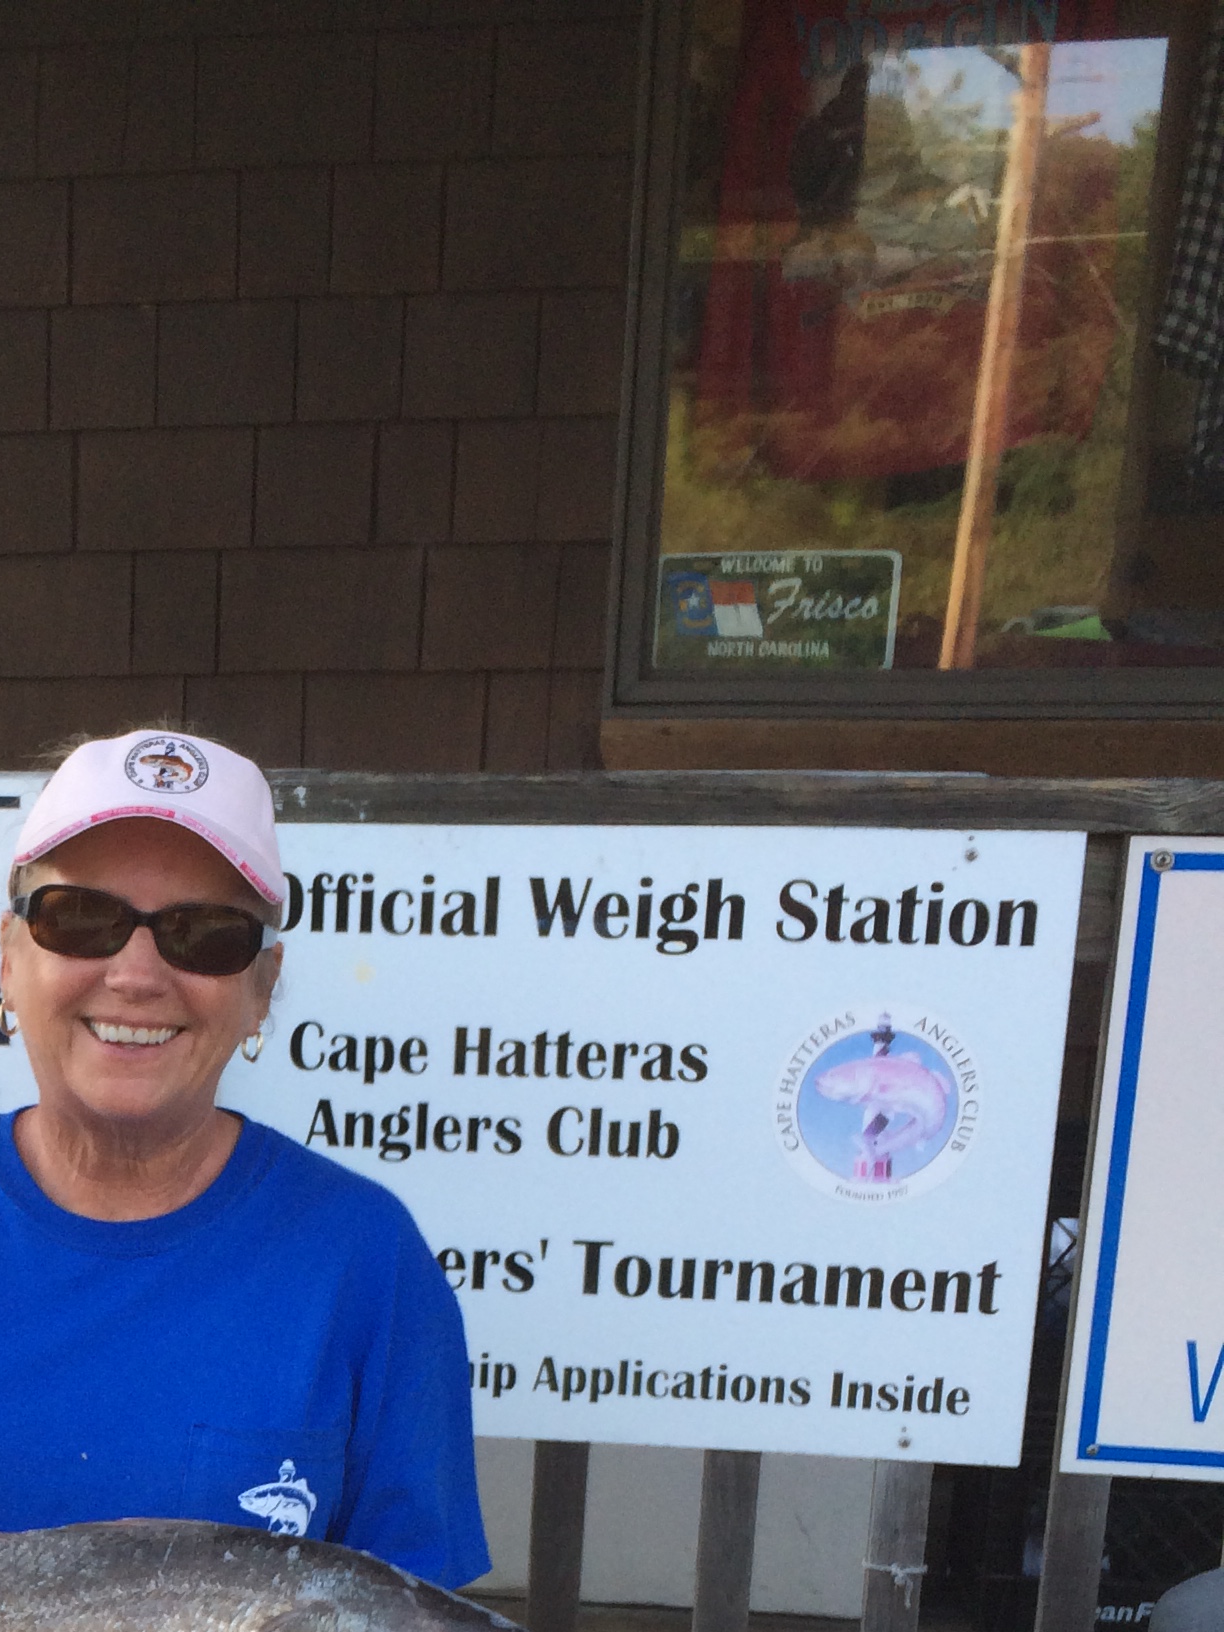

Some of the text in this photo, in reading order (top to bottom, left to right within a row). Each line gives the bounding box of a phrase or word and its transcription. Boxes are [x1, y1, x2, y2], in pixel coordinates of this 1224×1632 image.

[721, 554, 823, 574] WELCOME TO
[767, 577, 879, 624] Frisco
[708, 640, 829, 658] NORTH CAROLINA
[529, 877, 746, 955] Weigh
[776, 879, 1038, 947] Station
[289, 1020, 708, 1087] Cape Hatteras
[776, 1011, 980, 1152] CAPE HATTERAS ANGLERS CLUB
[306, 1098, 680, 1163] Anglers Club
[436, 1238, 1003, 1316] ers' Tournament
[532, 1356, 811, 1408] Applications
[830, 1372, 971, 1416] Inside
